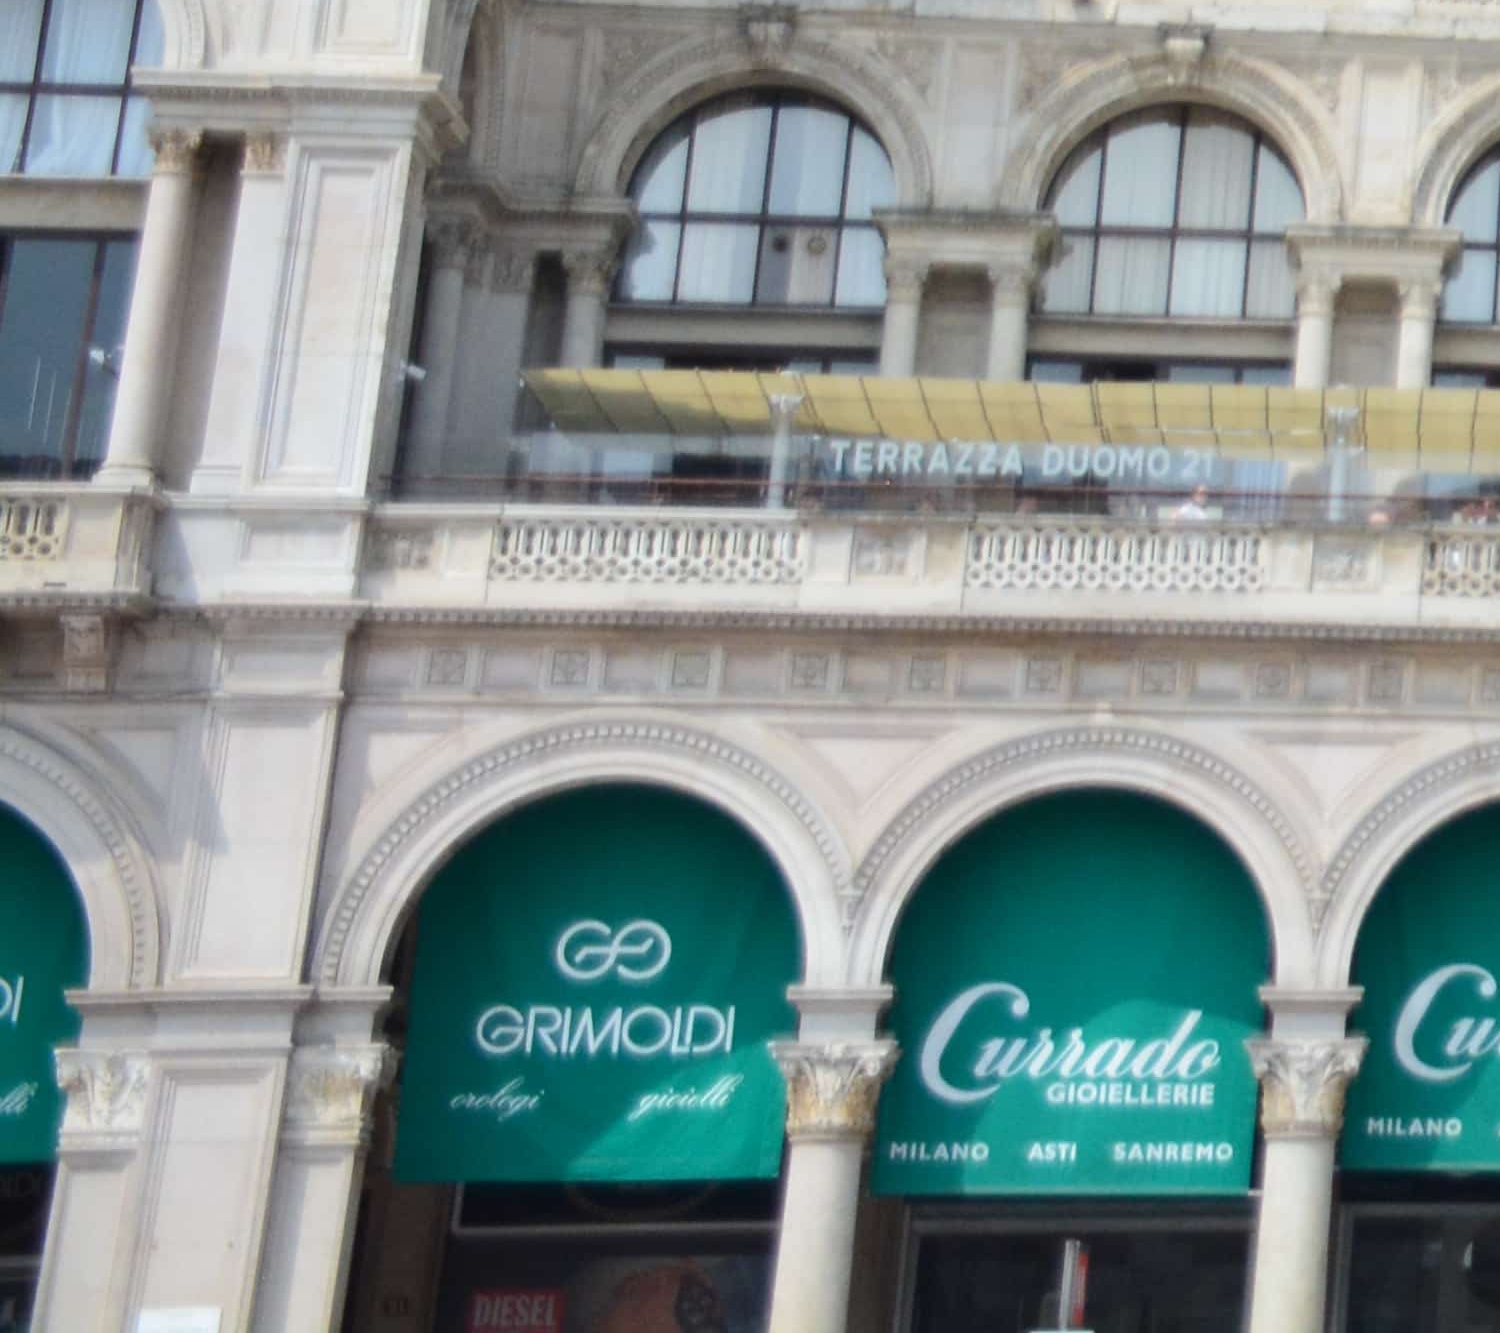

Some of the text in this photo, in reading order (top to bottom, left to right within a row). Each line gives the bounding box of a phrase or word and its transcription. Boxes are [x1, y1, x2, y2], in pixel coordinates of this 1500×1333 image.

[828, 439, 1216, 480] TERRAZZA DUOMO 21
[475, 1004, 736, 1056] GRIMOLDI
[920, 982, 1221, 1103] Currado
[448, 1072, 744, 1123] orologi gioielli
[1046, 1082, 1216, 1105] GIOIELLERIE
[1366, 1116, 1463, 1138] MILANO
[888, 1140, 1234, 1163] MILANO ASTI SANREMO
[472, 1293, 557, 1328] DIESEL
